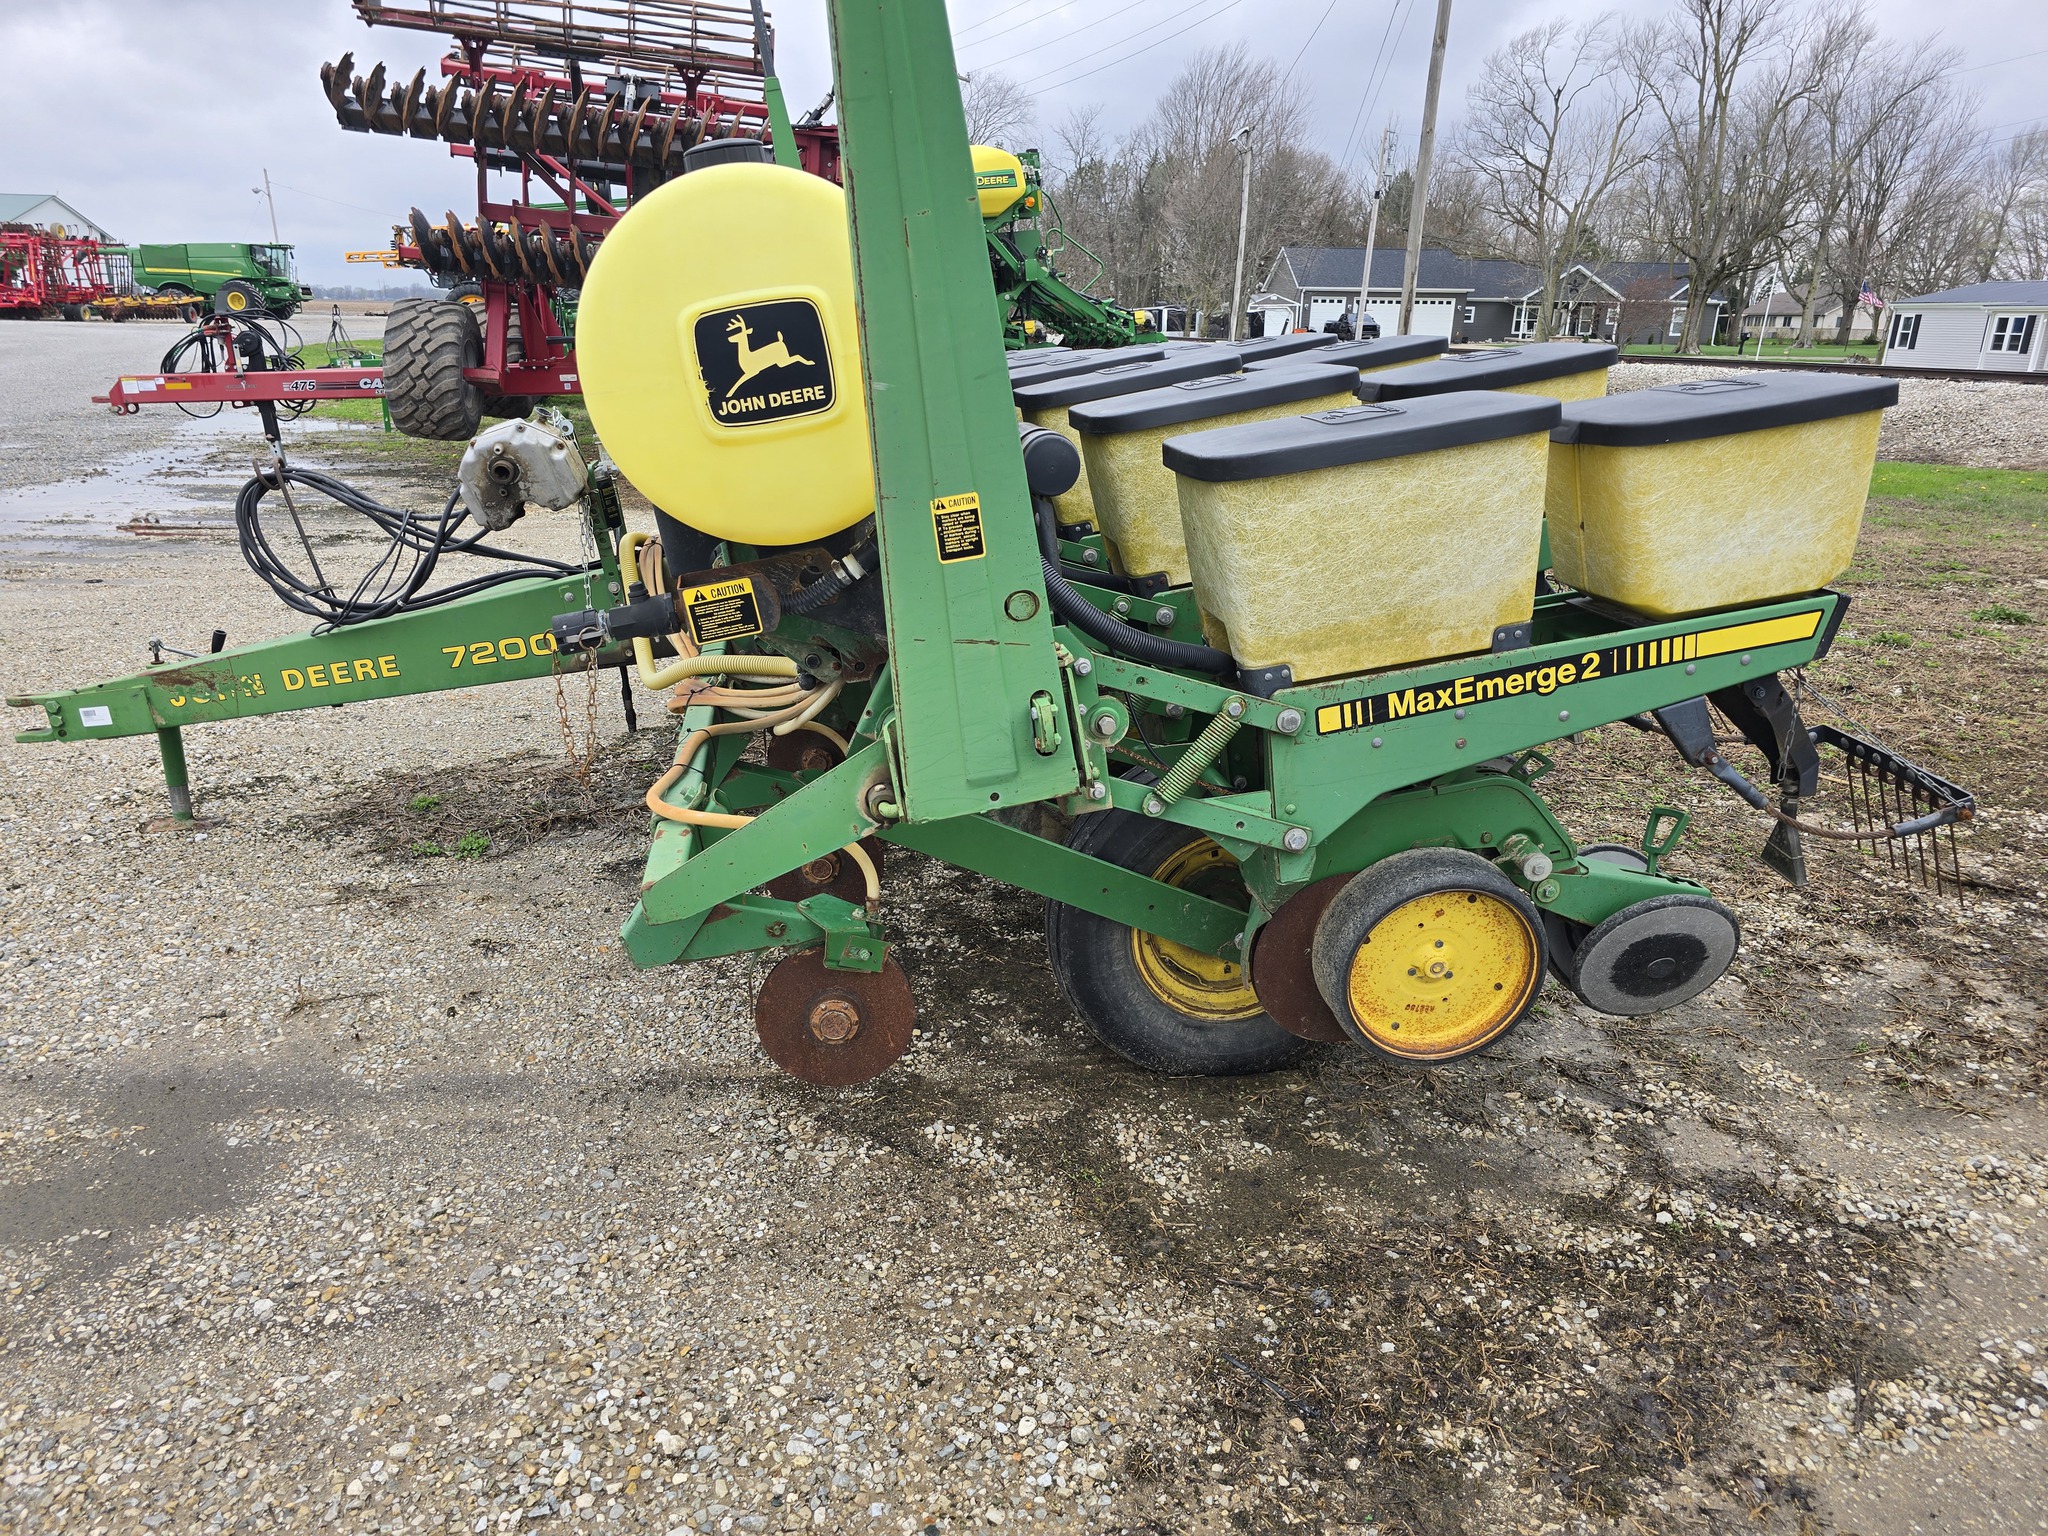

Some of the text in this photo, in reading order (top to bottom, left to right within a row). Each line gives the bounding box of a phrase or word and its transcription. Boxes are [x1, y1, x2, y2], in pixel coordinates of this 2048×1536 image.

[976, 176, 1009, 186] DEERE
[289, 380, 317, 391] 475
[359, 377, 384, 389] CA
[718, 385, 826, 416] JOHN DEERE
[948, 496, 976, 508] CAUTION
[710, 583, 746, 598] CAUTION
[441, 632, 558, 668] 7200
[280, 654, 401, 692] DEERE
[1387, 652, 1601, 719] MaxEmerge 2
